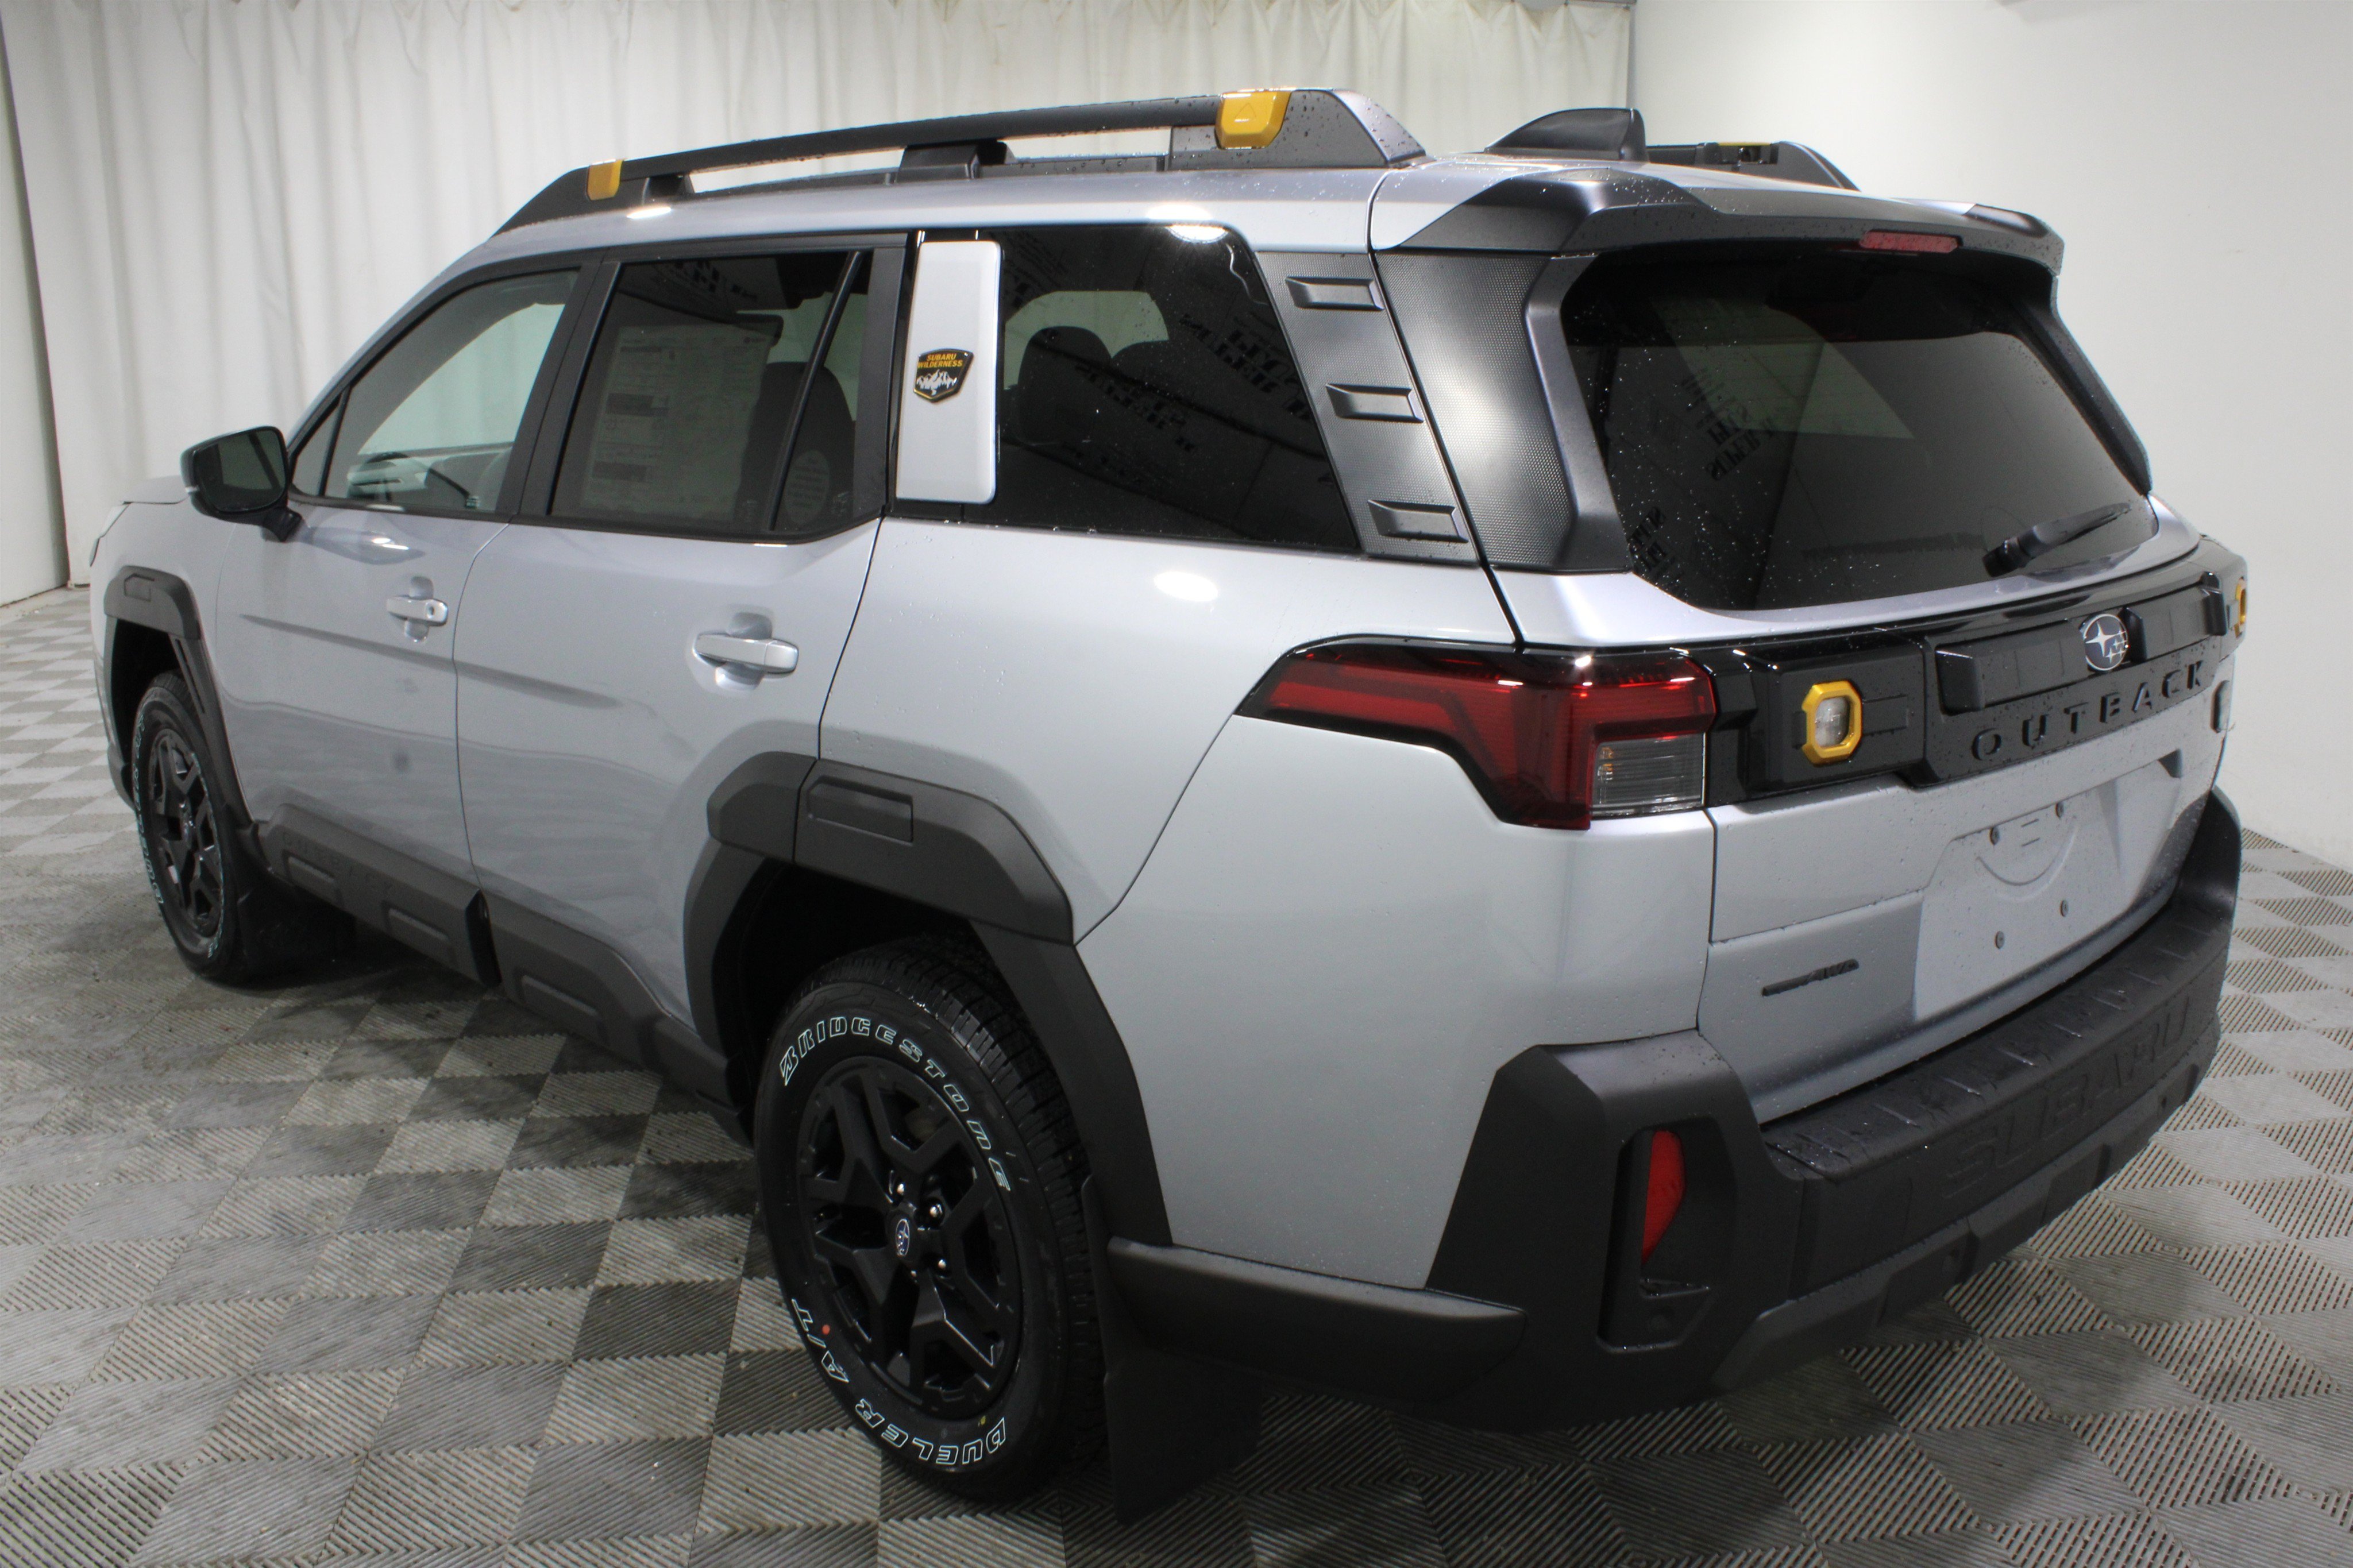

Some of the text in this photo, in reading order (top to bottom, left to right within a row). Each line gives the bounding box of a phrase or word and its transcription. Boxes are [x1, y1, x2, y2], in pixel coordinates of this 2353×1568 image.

[918, 360, 963, 368] WILDERNESS
[927, 353, 957, 361] SUBARU
[1972, 660, 2205, 762] OUTBACK
[779, 1015, 1011, 1192] BRIDGESTONE
[1942, 994, 2192, 1200] SUBARU
[854, 1396, 1006, 1466] DUELER
